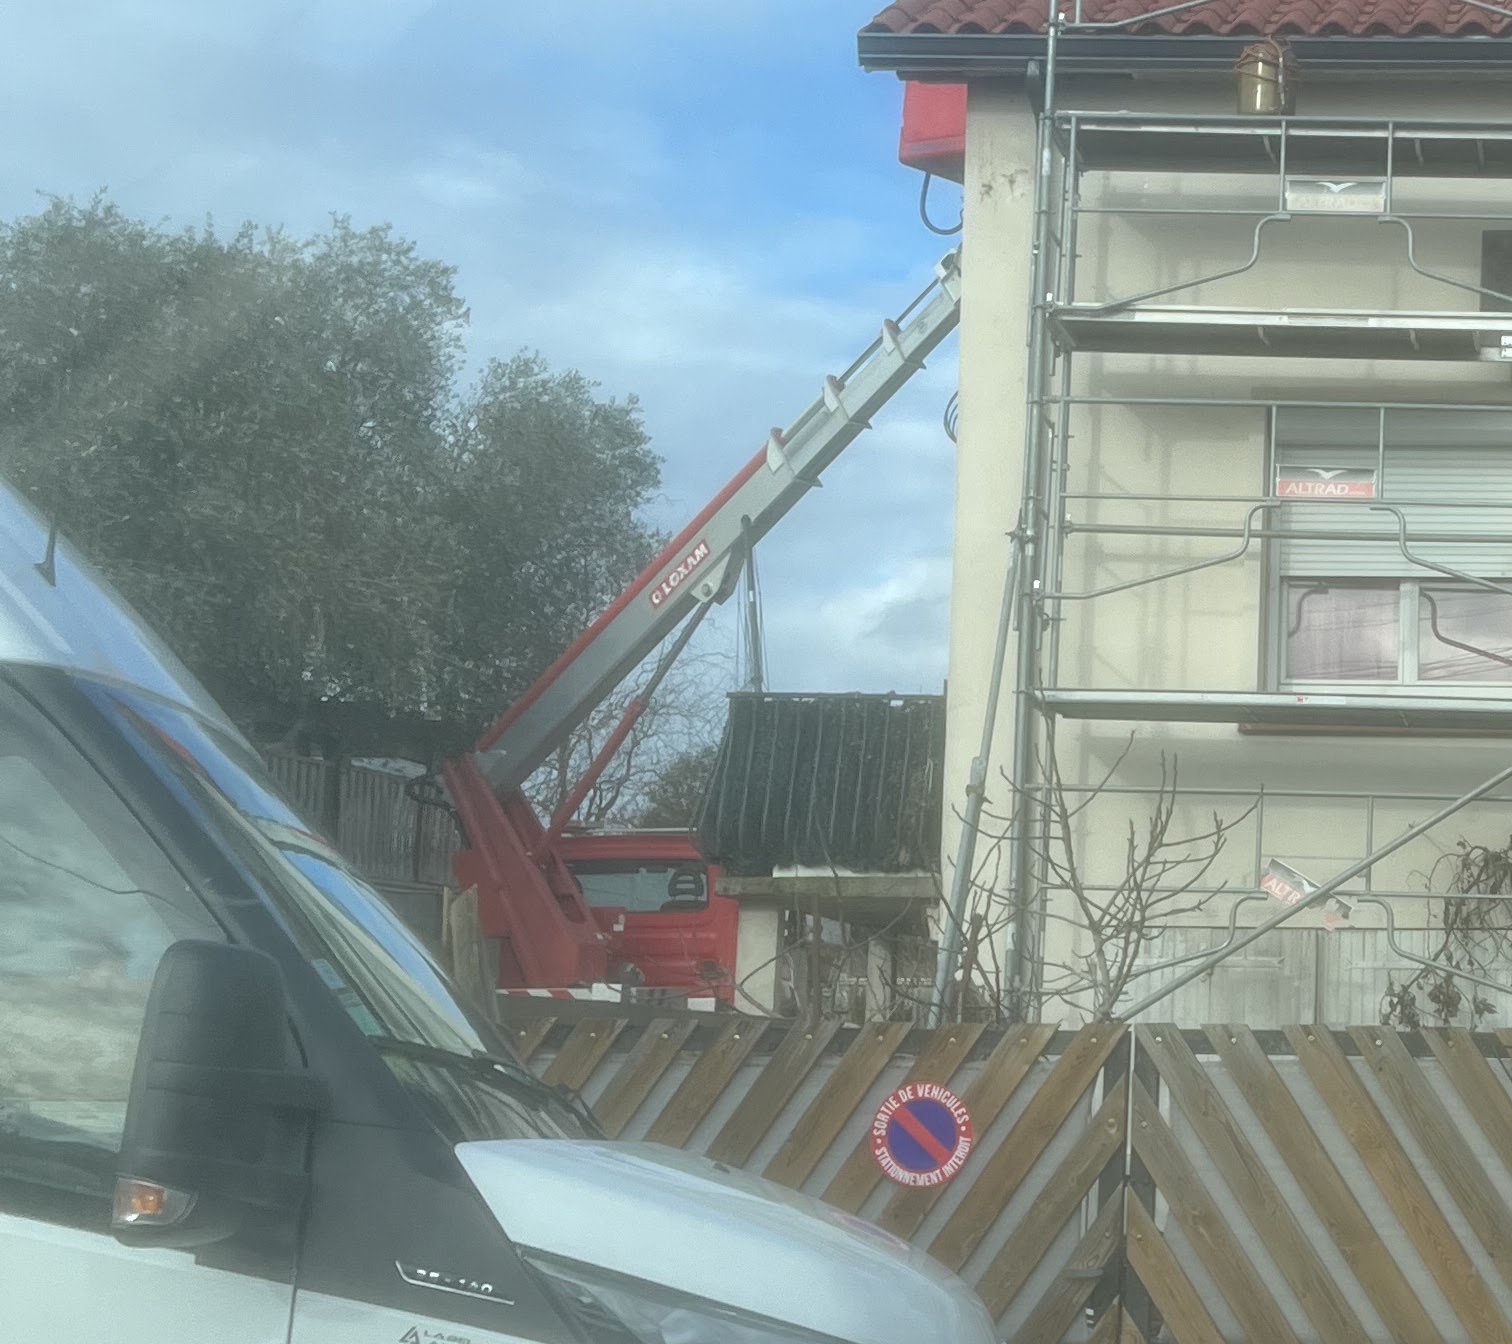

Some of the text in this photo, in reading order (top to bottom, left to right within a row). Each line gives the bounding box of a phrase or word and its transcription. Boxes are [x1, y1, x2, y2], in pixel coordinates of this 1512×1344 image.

[1285, 482, 1349, 495] ALTRAD
[661, 543, 709, 596] LOXAM
[1264, 878, 1302, 904] ALTR
[873, 1083, 970, 1136] SORTIE DE VEHICULES
[874, 1136, 971, 1186] STATIONNEMENT INTERDIT
